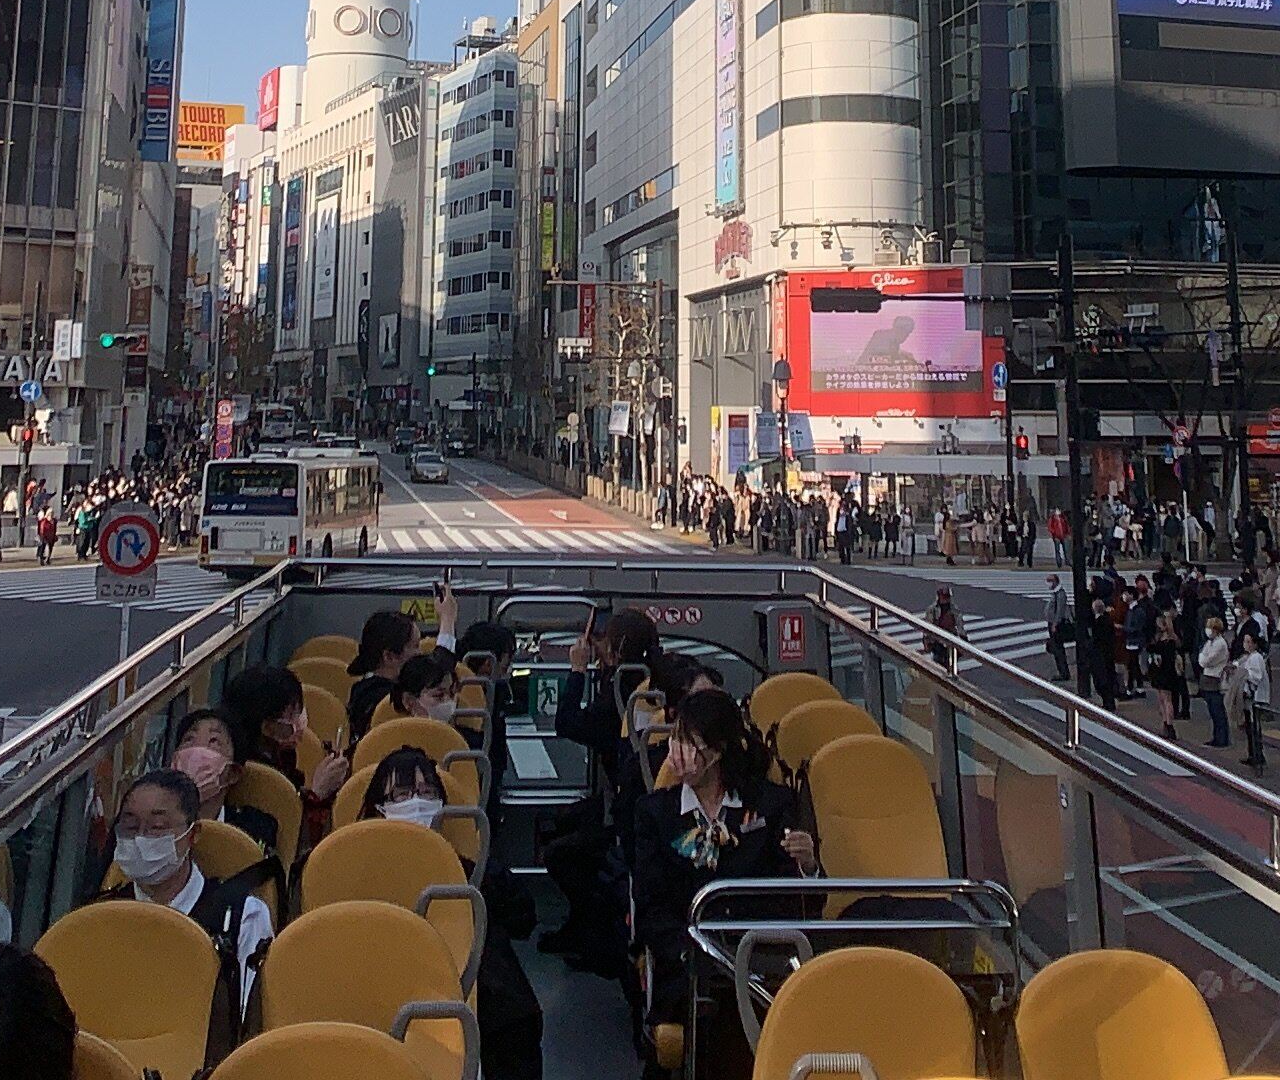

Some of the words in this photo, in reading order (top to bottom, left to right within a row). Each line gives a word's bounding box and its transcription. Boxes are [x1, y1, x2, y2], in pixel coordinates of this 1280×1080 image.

[144, 58, 171, 143] SEIBU
[181, 104, 226, 126] TOWER
[870, 272, 916, 291] Glico
[99, 581, 151, 598] ここから
